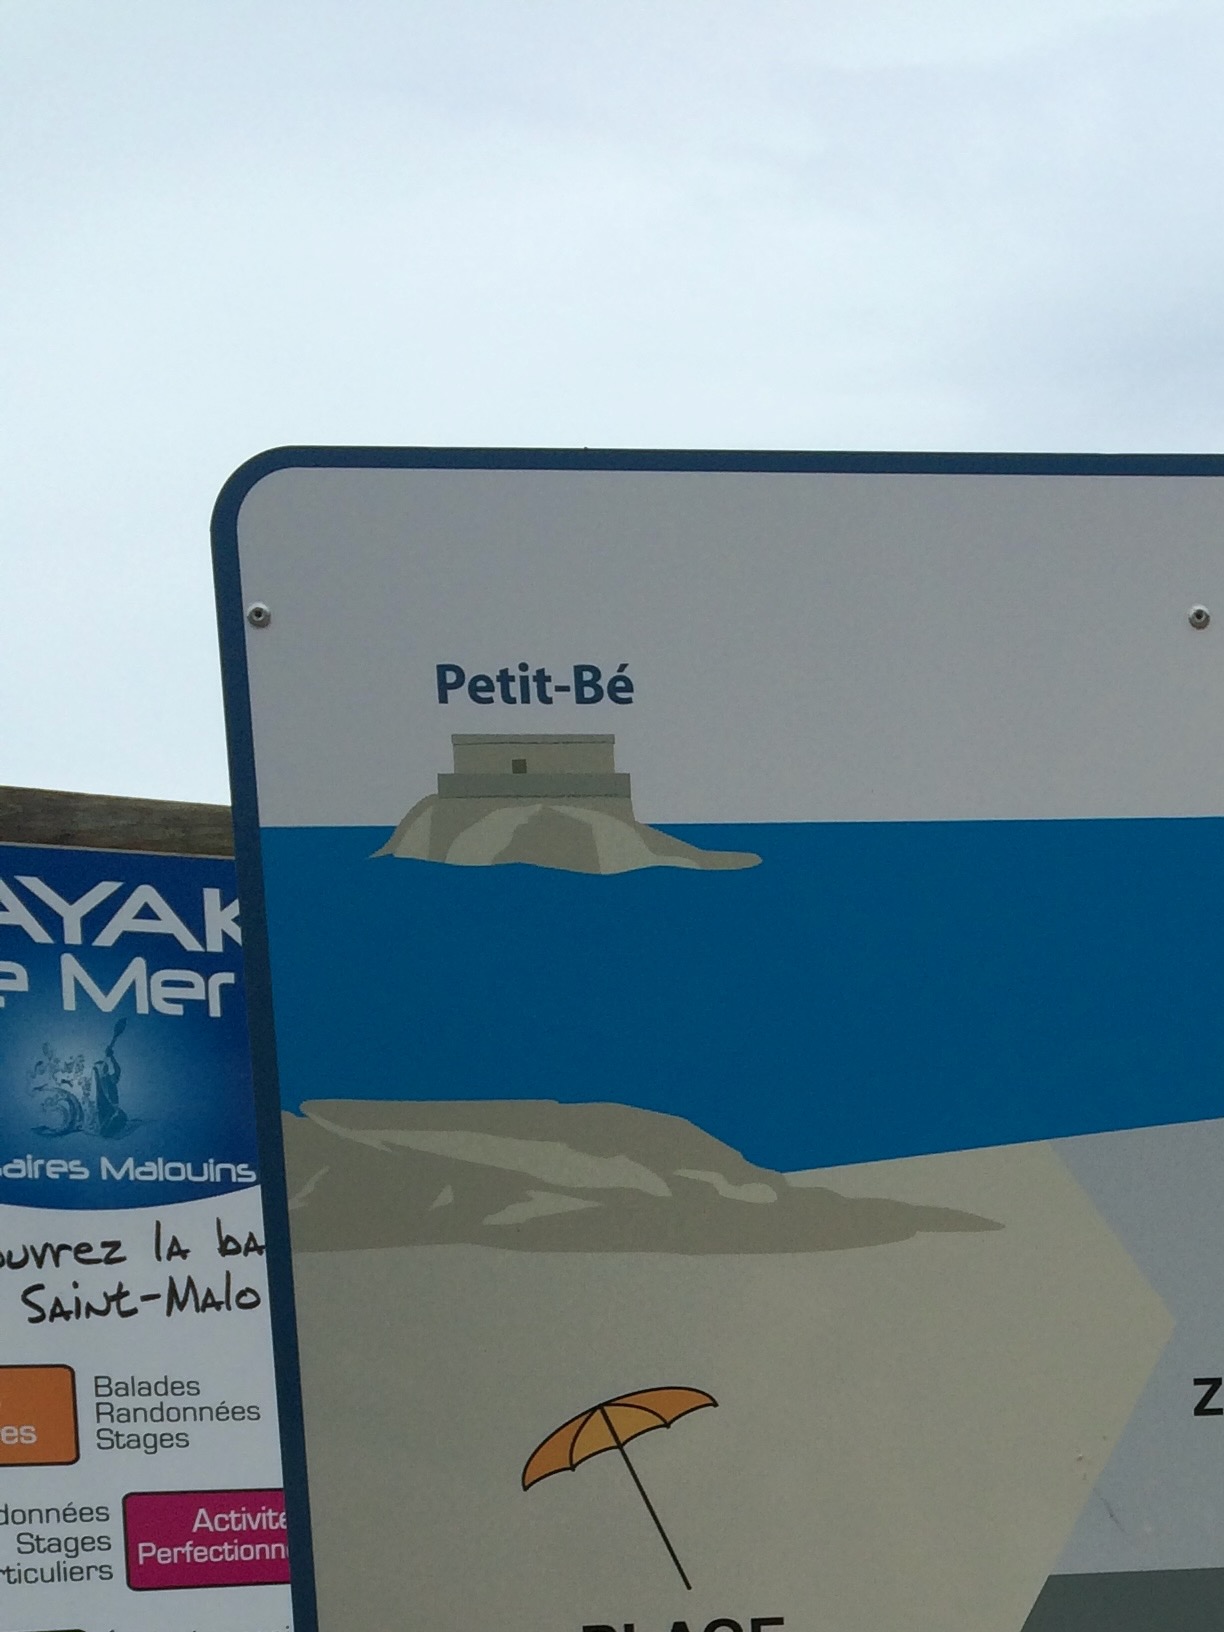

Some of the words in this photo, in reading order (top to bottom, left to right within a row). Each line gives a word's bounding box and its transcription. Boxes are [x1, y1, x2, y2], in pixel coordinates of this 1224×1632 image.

[436, 661, 635, 706] Petit-Bé
[60, 952, 236, 1018] Mer
[0, 1154, 90, 1181] aires
[100, 1156, 257, 1184] Malouins
[0, 1240, 127, 1270] uvrez
[94, 1375, 201, 1398] Balades
[95, 1401, 262, 1425] Randonnées
[96, 1427, 190, 1455] Stages
[16, 1531, 113, 1559] Stages
[138, 1538, 290, 1566] Perfectionn
